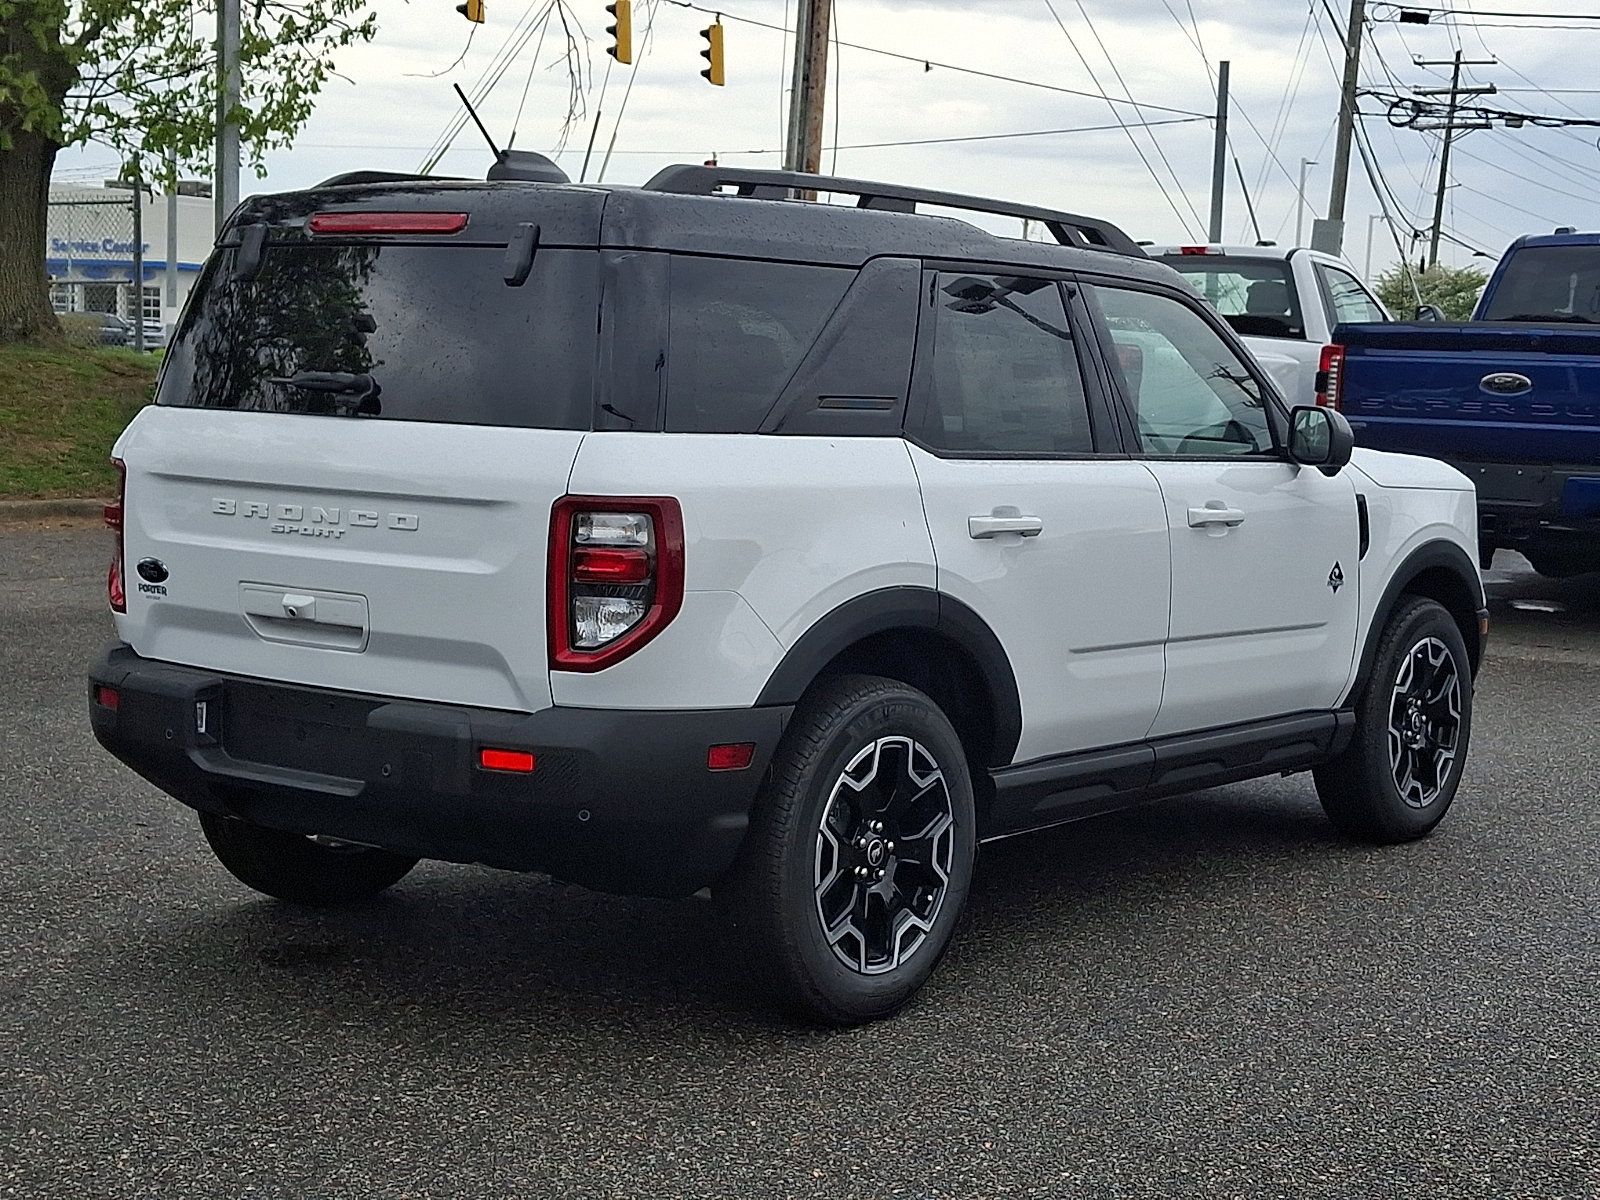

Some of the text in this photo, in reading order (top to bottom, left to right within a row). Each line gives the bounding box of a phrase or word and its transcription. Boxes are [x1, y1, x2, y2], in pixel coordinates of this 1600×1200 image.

[102, 238, 150, 253] Centr
[212, 498, 420, 531] BRONCO
[271, 524, 346, 539] SPORT
[137, 583, 168, 596] PORTER
